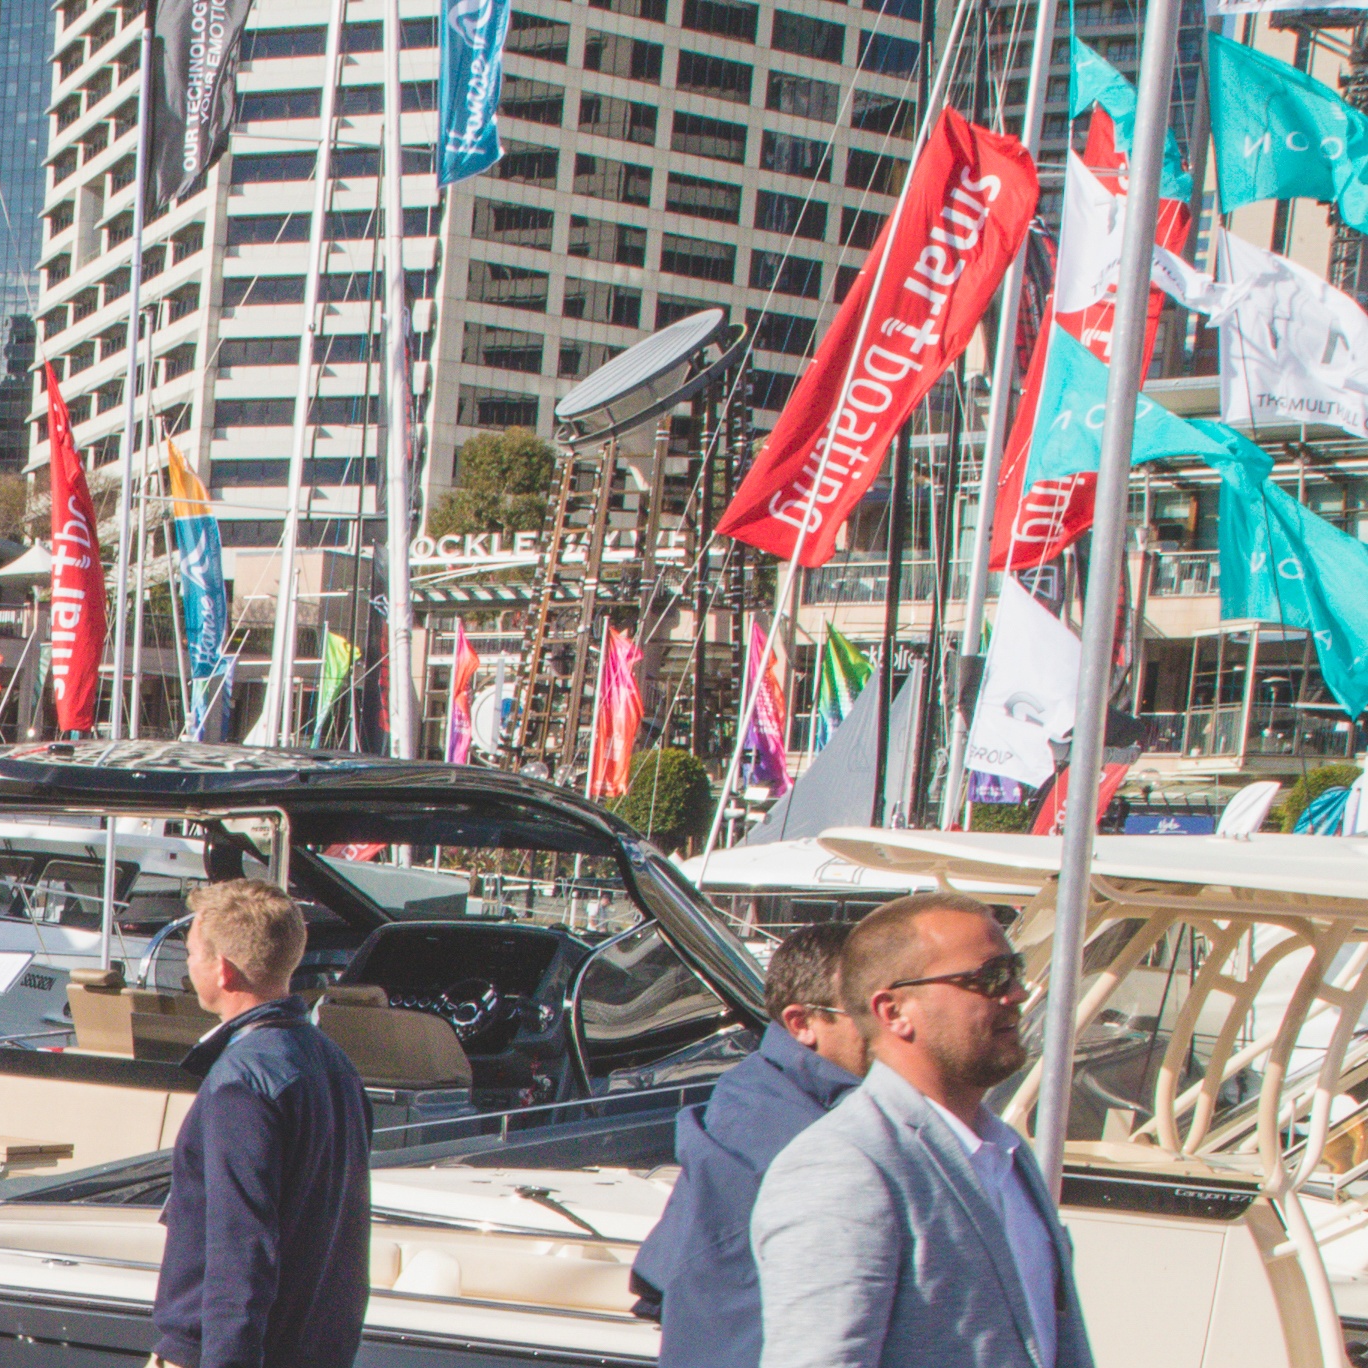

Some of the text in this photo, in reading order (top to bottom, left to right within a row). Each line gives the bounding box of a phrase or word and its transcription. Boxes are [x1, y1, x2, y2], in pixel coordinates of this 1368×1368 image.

[183, 0, 208, 172] OUR TECHNOLOG
[200, 72, 217, 125] YOUR
[445, 54, 490, 155] Hanse
[407, 530, 538, 560] OCKLE
[189, 596, 218, 665] Hanse
[1174, 1188, 1227, 1201] Canyon
